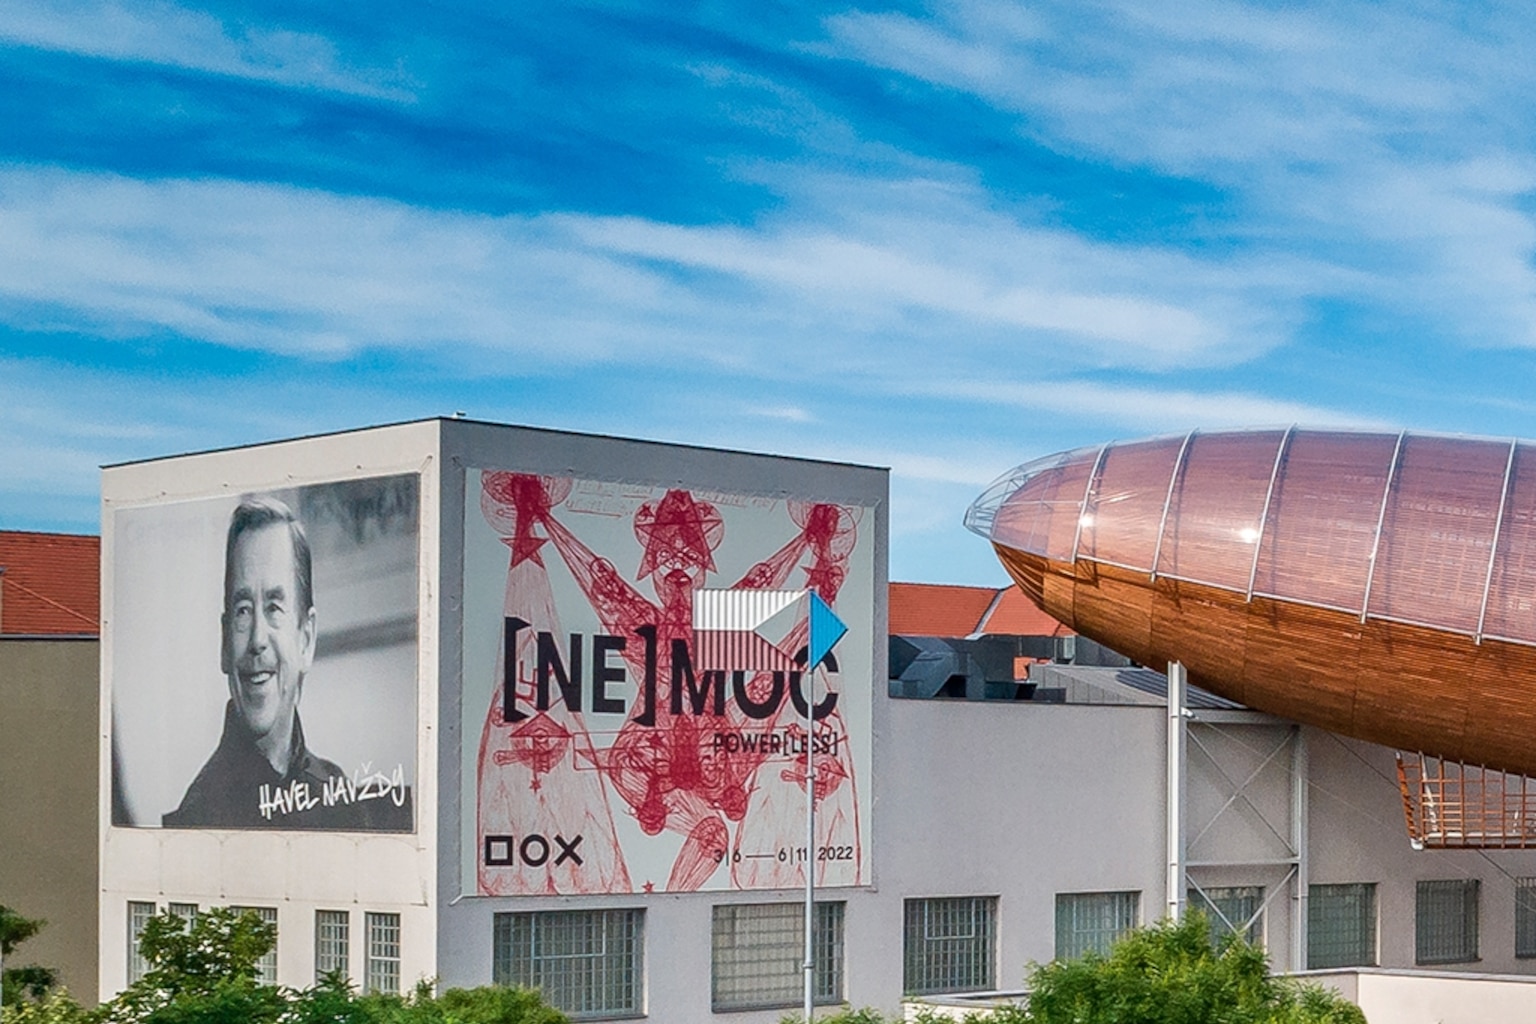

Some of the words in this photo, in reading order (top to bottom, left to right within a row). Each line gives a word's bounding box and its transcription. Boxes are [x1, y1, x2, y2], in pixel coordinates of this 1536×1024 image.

[713, 731, 838, 756] POWER[LESS]
[259, 779, 320, 820] HAVEL
[323, 761, 405, 807] NAVŽDY
[486, 833, 584, 867] DOX
[817, 846, 853, 861] 2022
